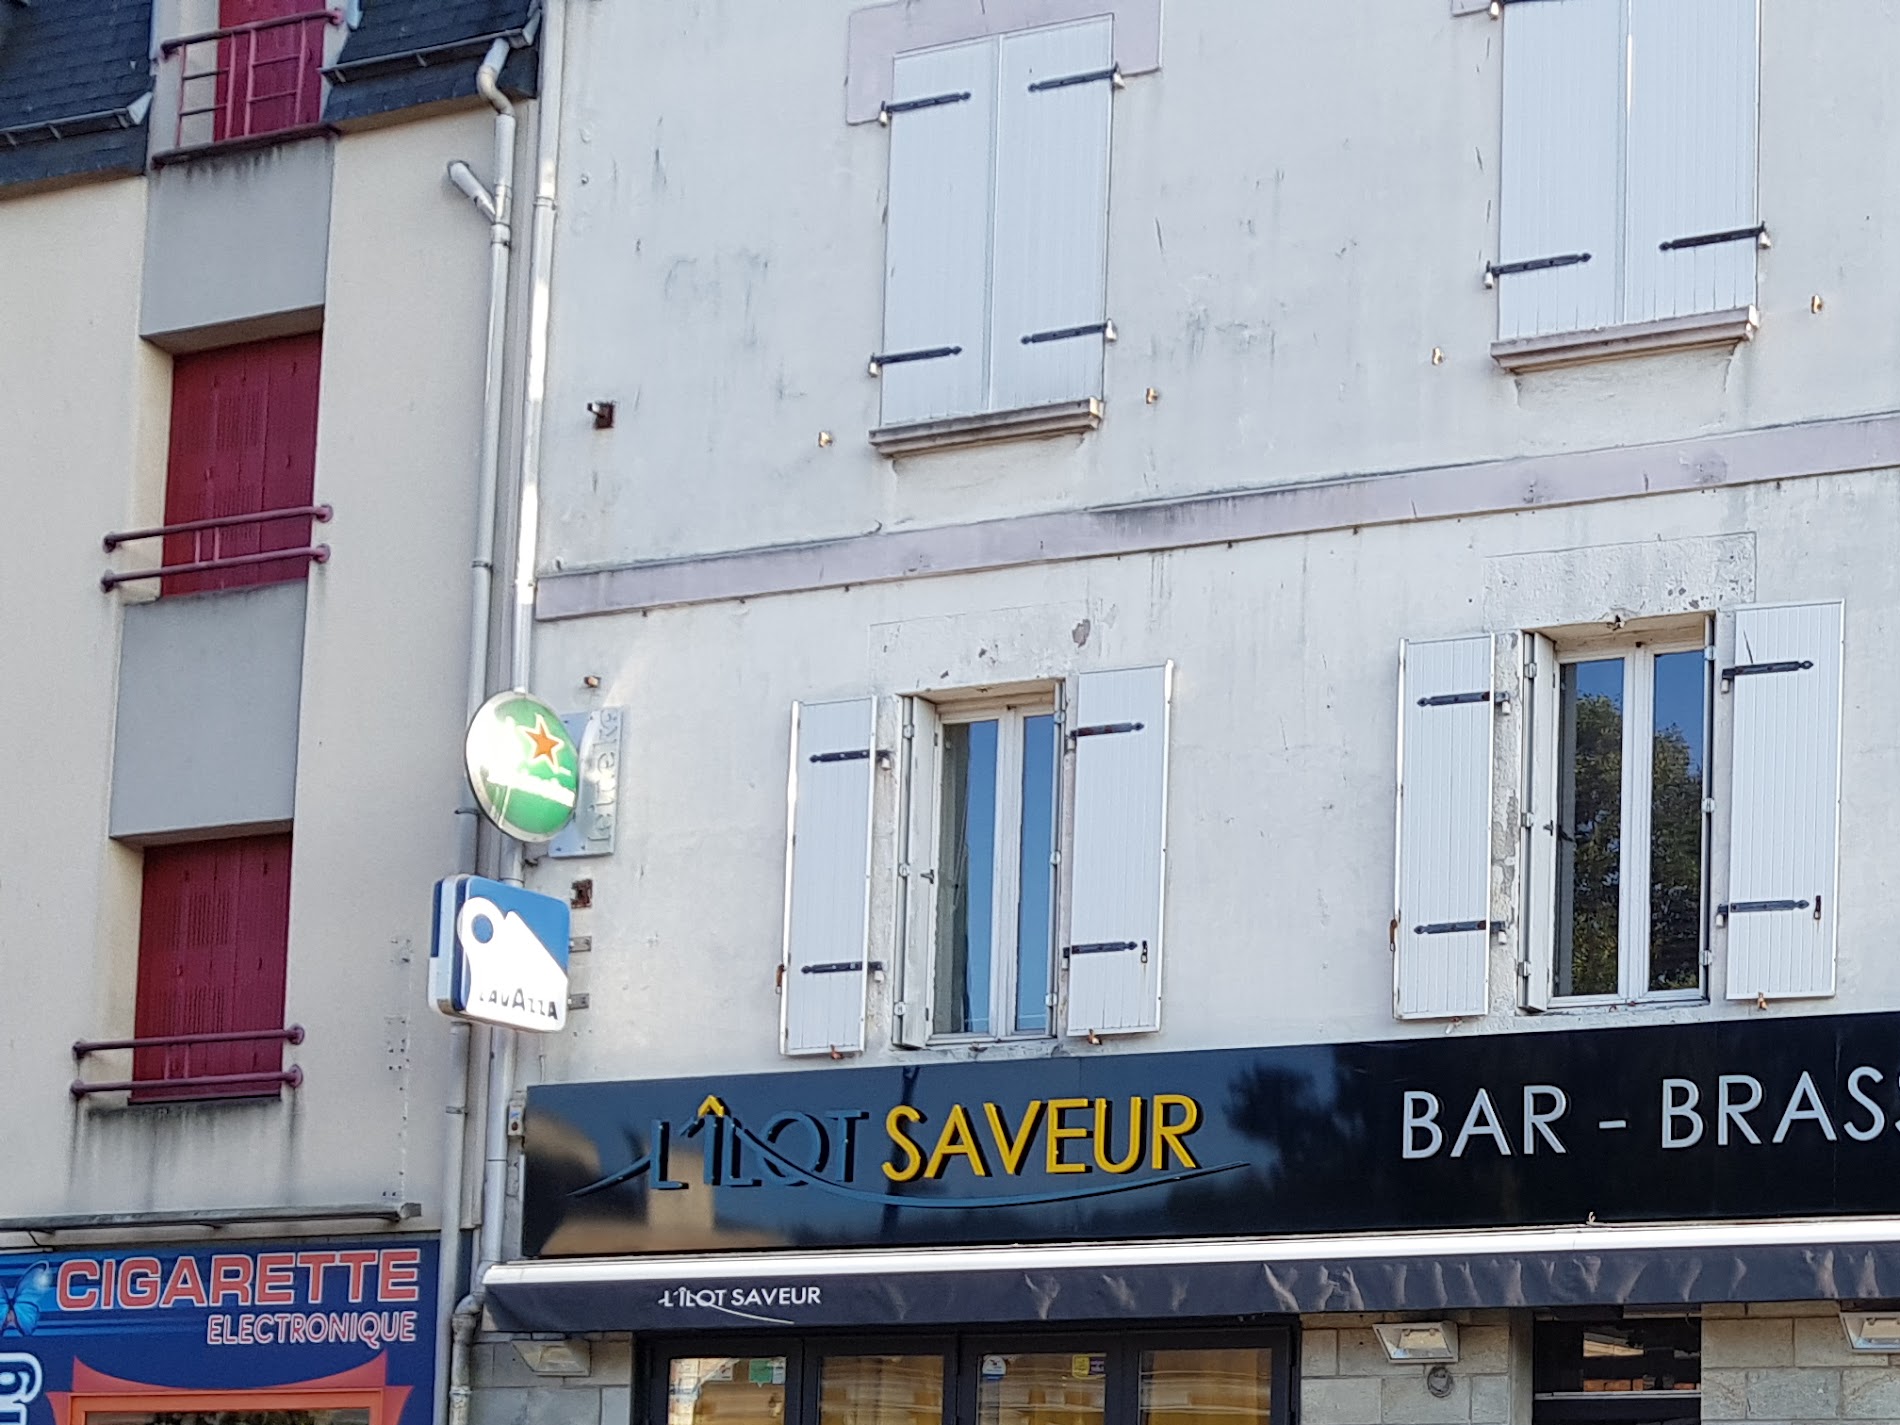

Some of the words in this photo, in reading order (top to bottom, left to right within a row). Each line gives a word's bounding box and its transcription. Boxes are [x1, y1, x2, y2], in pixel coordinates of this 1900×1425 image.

[881, 1093, 1199, 1182] SAVEUR
[1402, 1083, 1568, 1161] BAR
[55, 1247, 422, 1313] CIGARETTE
[730, 1286, 822, 1307] SAVEUR
[206, 1309, 418, 1349] ELECTRONIQUE
